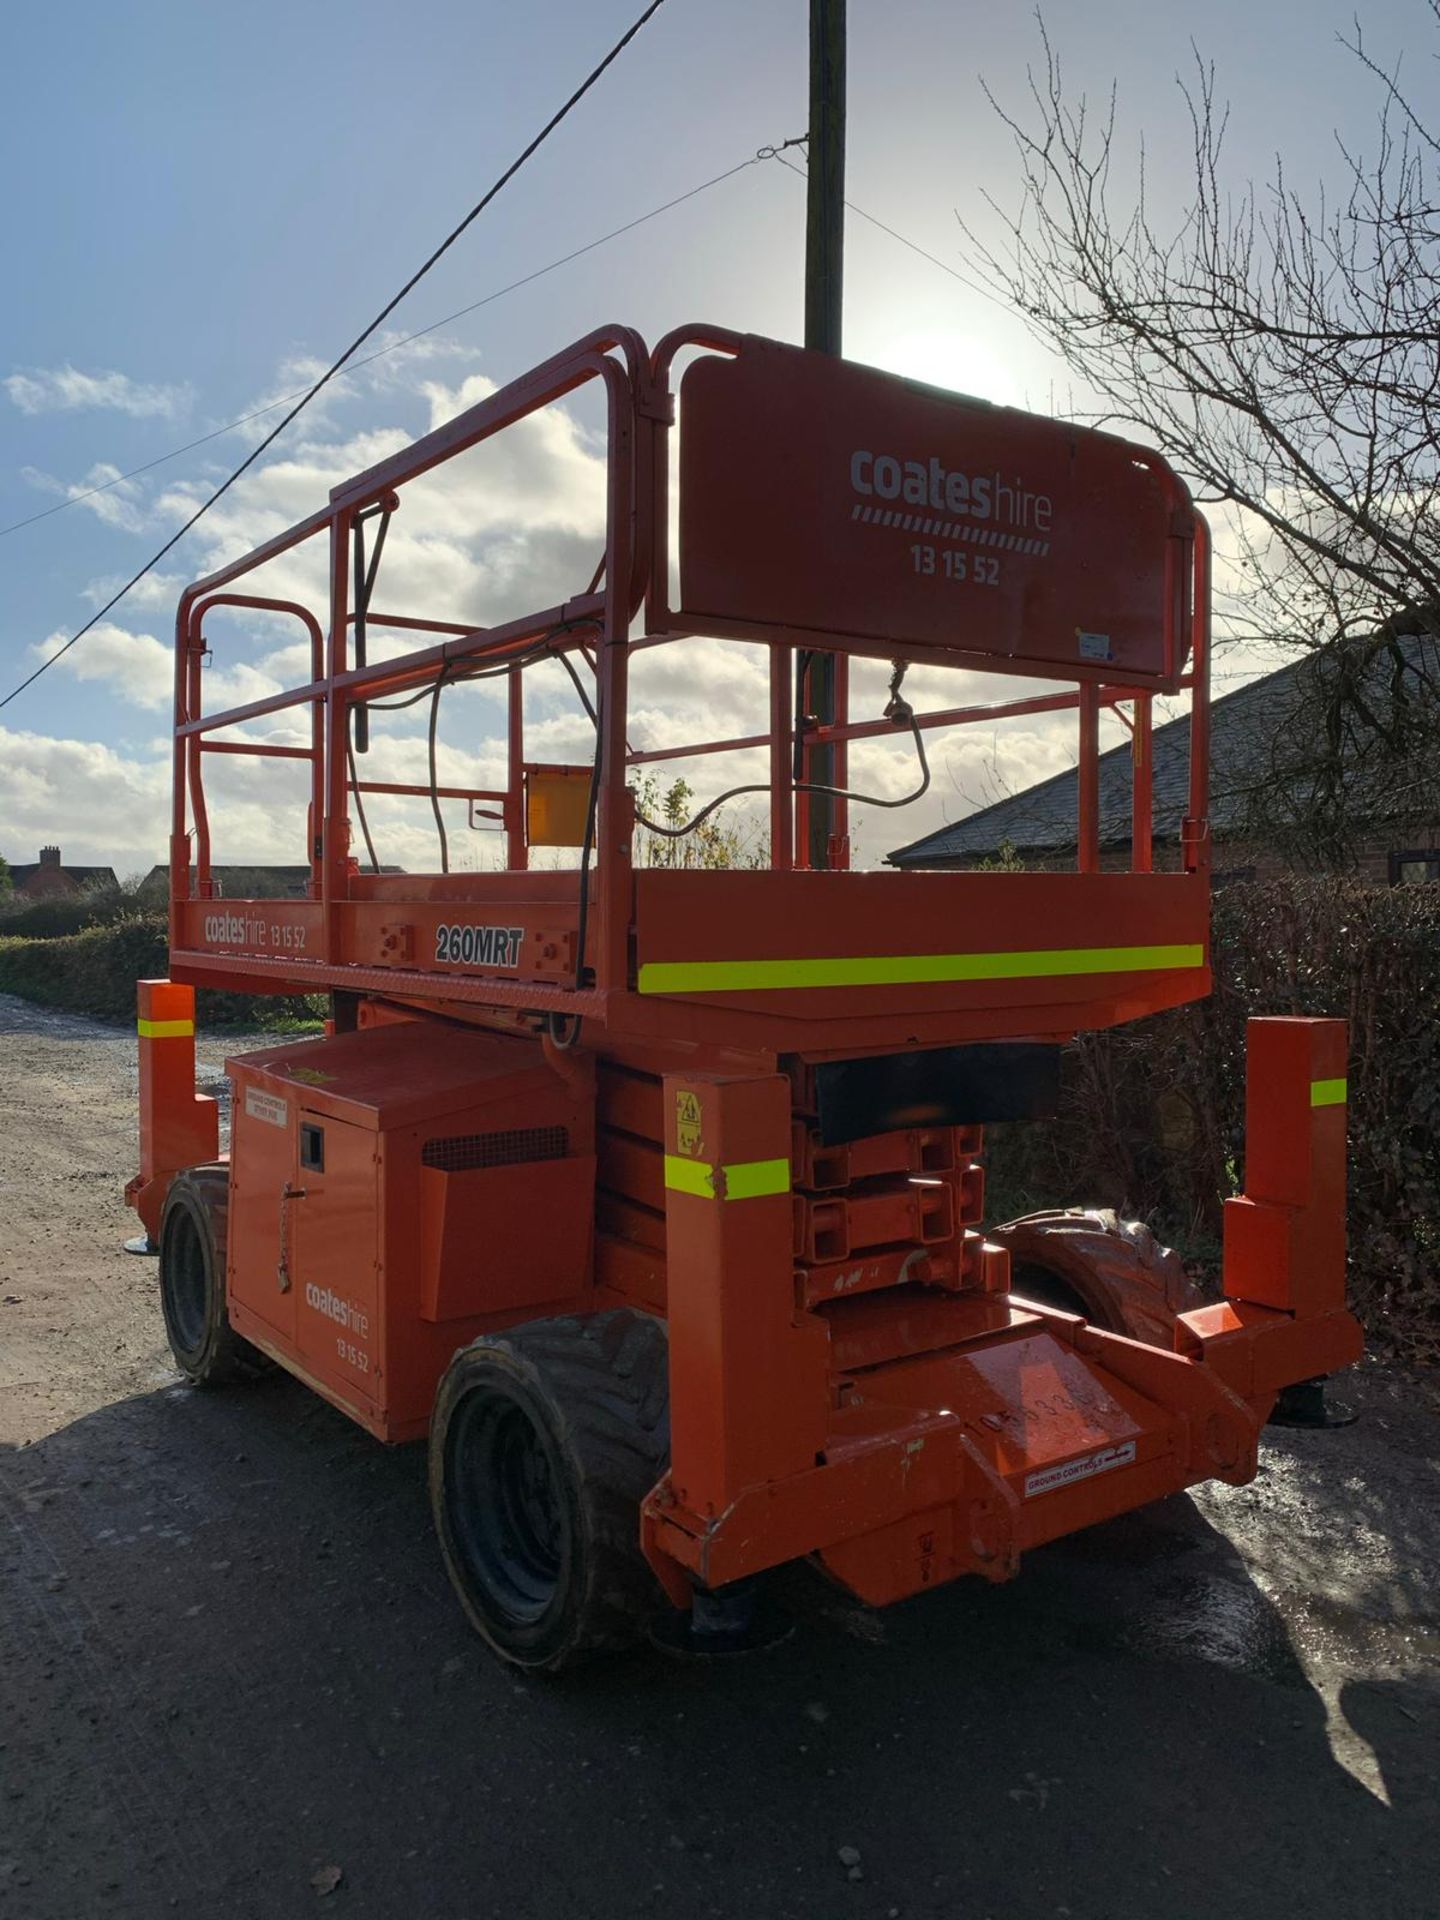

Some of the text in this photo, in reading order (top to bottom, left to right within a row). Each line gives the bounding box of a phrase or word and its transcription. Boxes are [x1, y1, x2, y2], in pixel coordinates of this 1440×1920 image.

[911, 544, 999, 585] 13 15 52
[271, 925, 280, 946] 13
[282, 926, 292, 947] 15
[294, 926, 306, 949] 52
[435, 924, 525, 968] 260MRT
[336, 1338, 368, 1373] 13 15 52
[1028, 1458, 1103, 1490] GROUND CONTROLS
